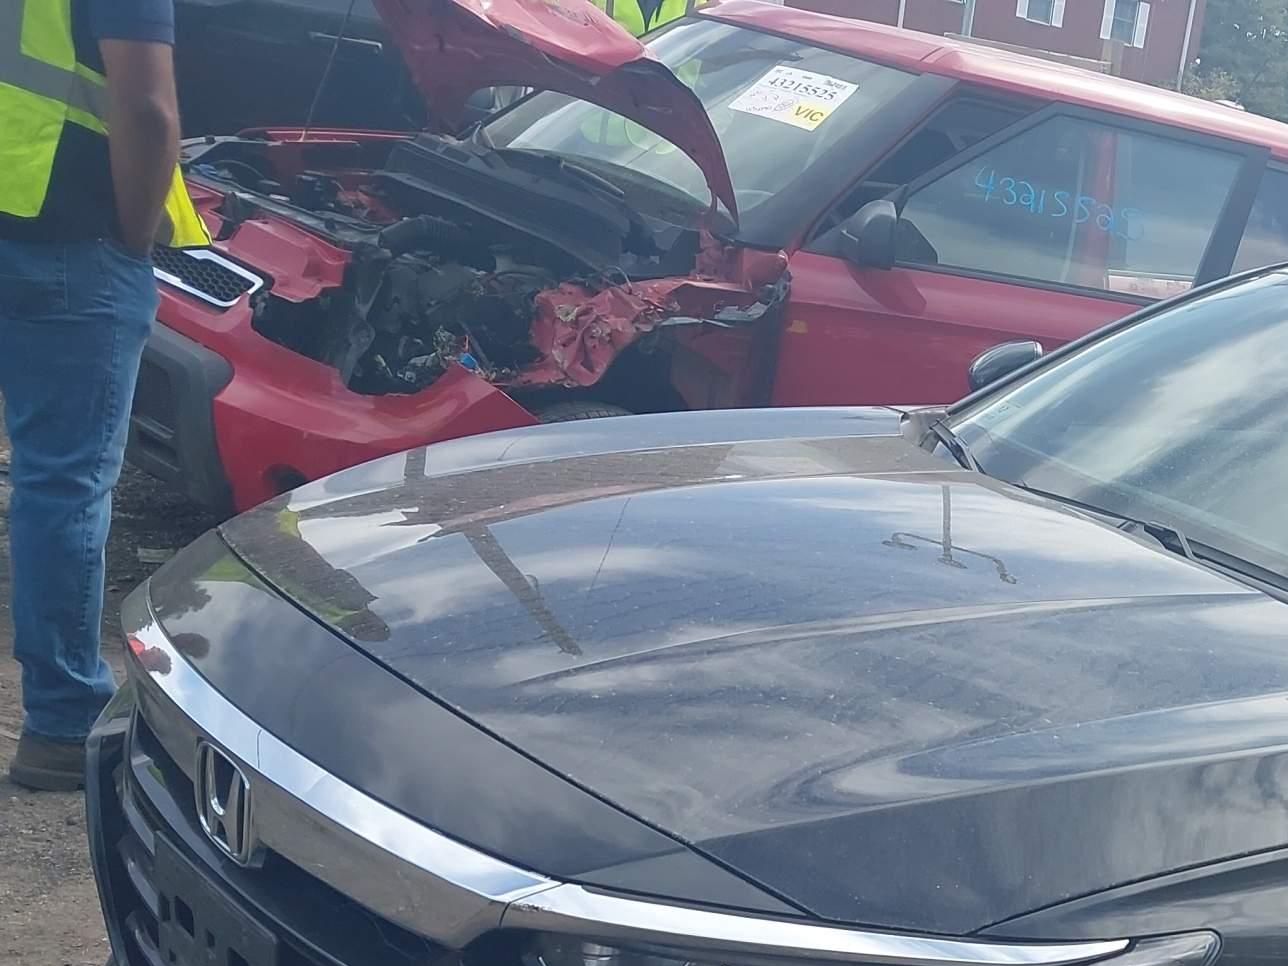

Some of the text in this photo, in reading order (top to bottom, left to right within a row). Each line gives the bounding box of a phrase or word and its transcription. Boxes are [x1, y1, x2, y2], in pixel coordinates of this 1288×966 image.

[768, 77, 838, 101] 43215525
[794, 105, 825, 122] VIC
[974, 166, 1145, 241] 43215525
